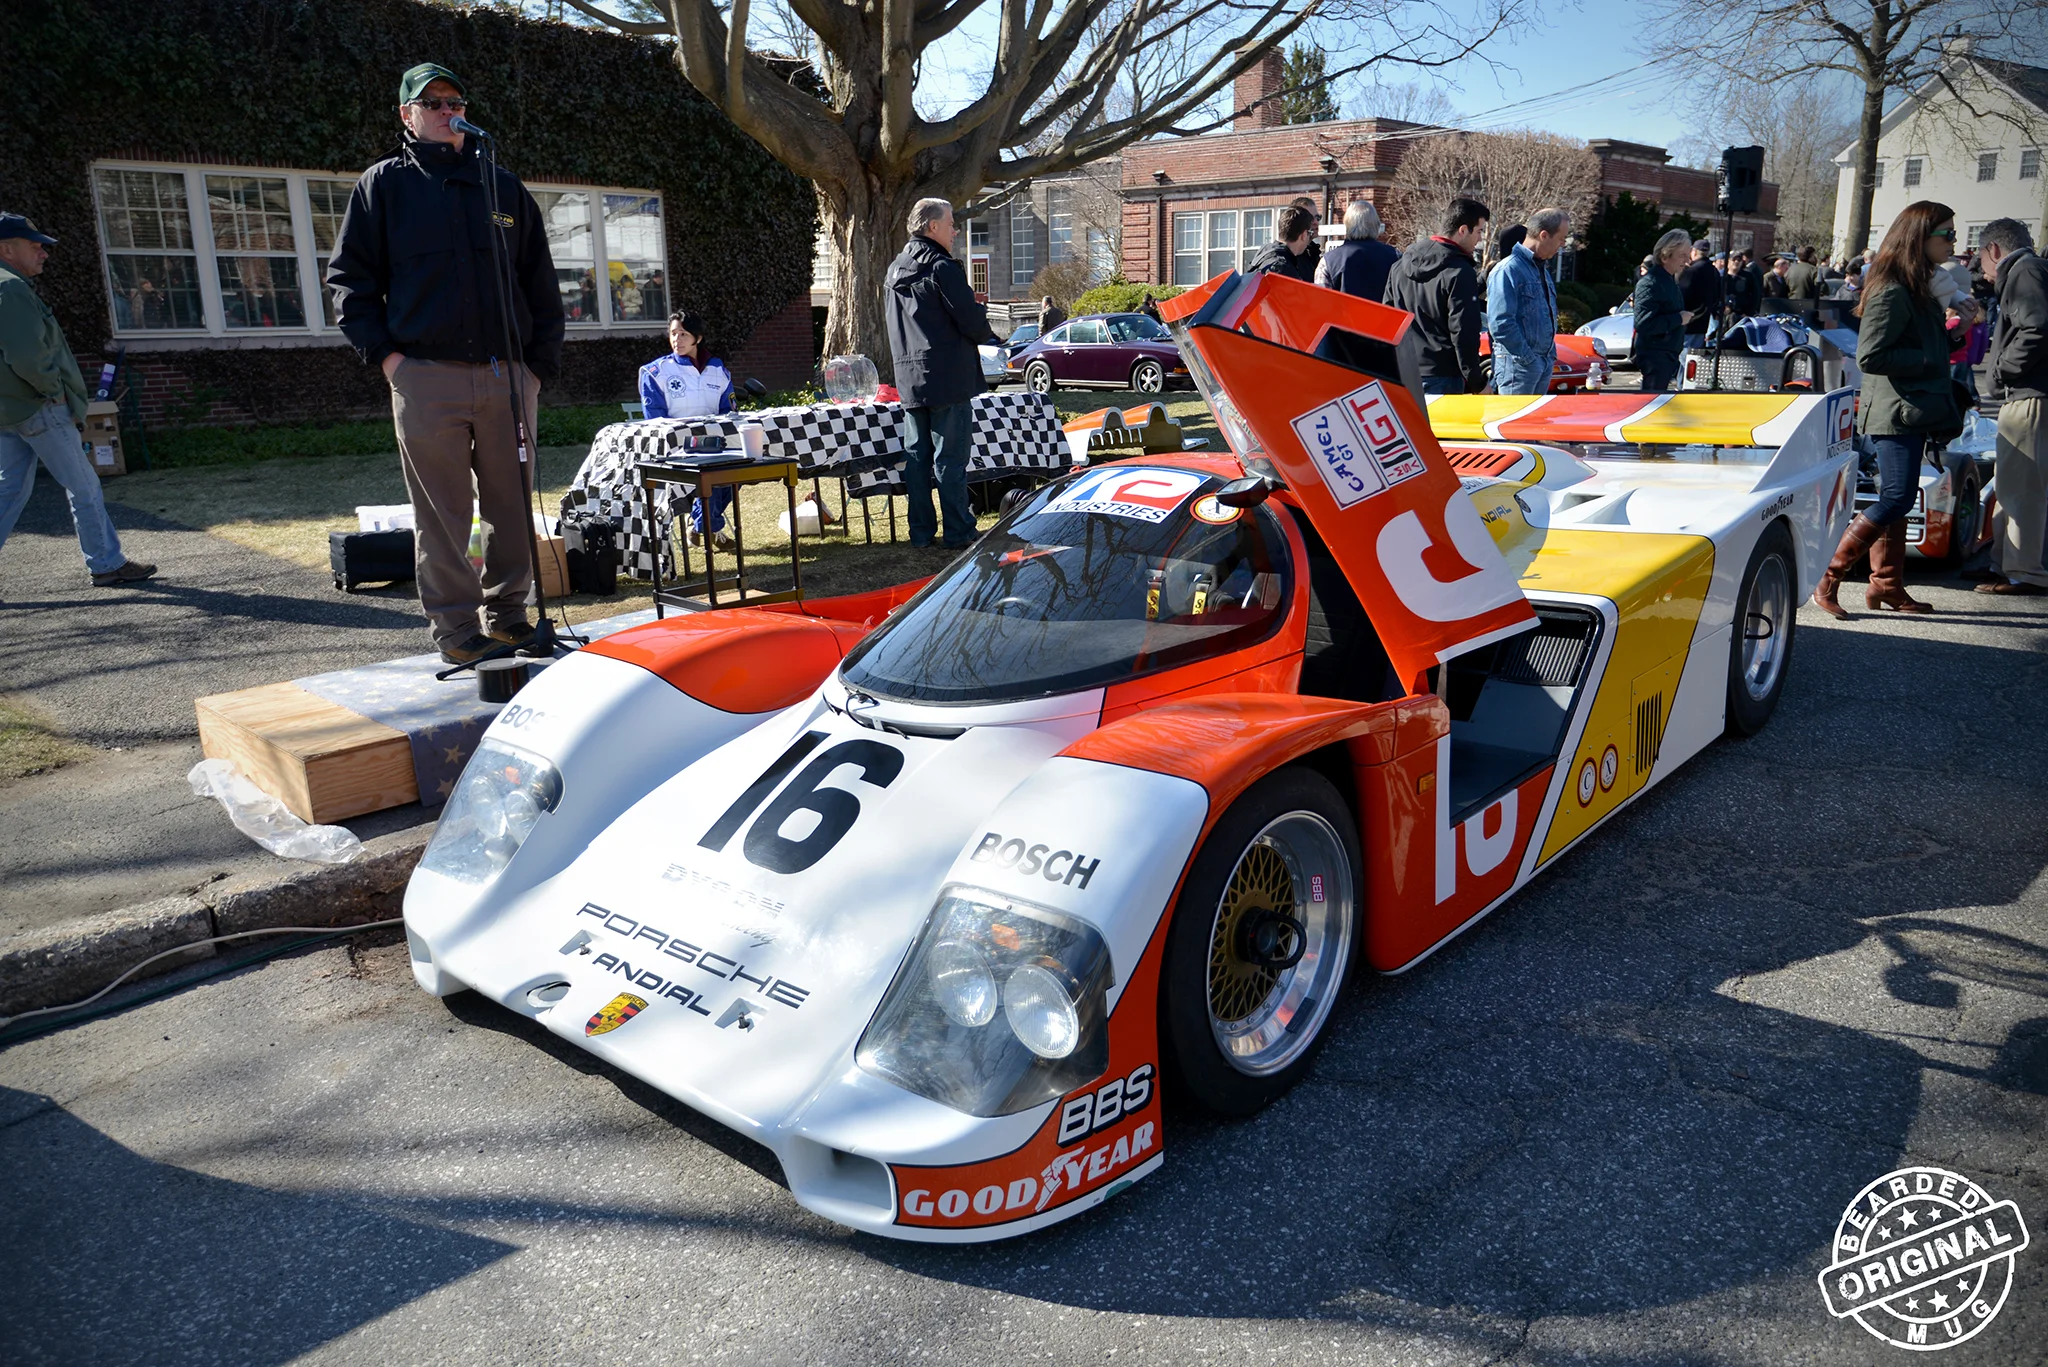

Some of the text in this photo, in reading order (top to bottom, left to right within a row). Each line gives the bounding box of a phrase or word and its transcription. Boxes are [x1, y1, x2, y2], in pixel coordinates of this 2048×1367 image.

[1315, 415, 1365, 492] CAMEL
[1336, 443, 1354, 461] GT
[1046, 501, 1168, 521] INDUSTRIES
[696, 730, 905, 875] 16
[970, 831, 1102, 890] BOSCH
[1311, 876, 1324, 902] BBS
[576, 901, 811, 1009] PORSCHE
[592, 952, 712, 1017] ANDIAL
[1055, 1063, 1156, 1148] BBS
